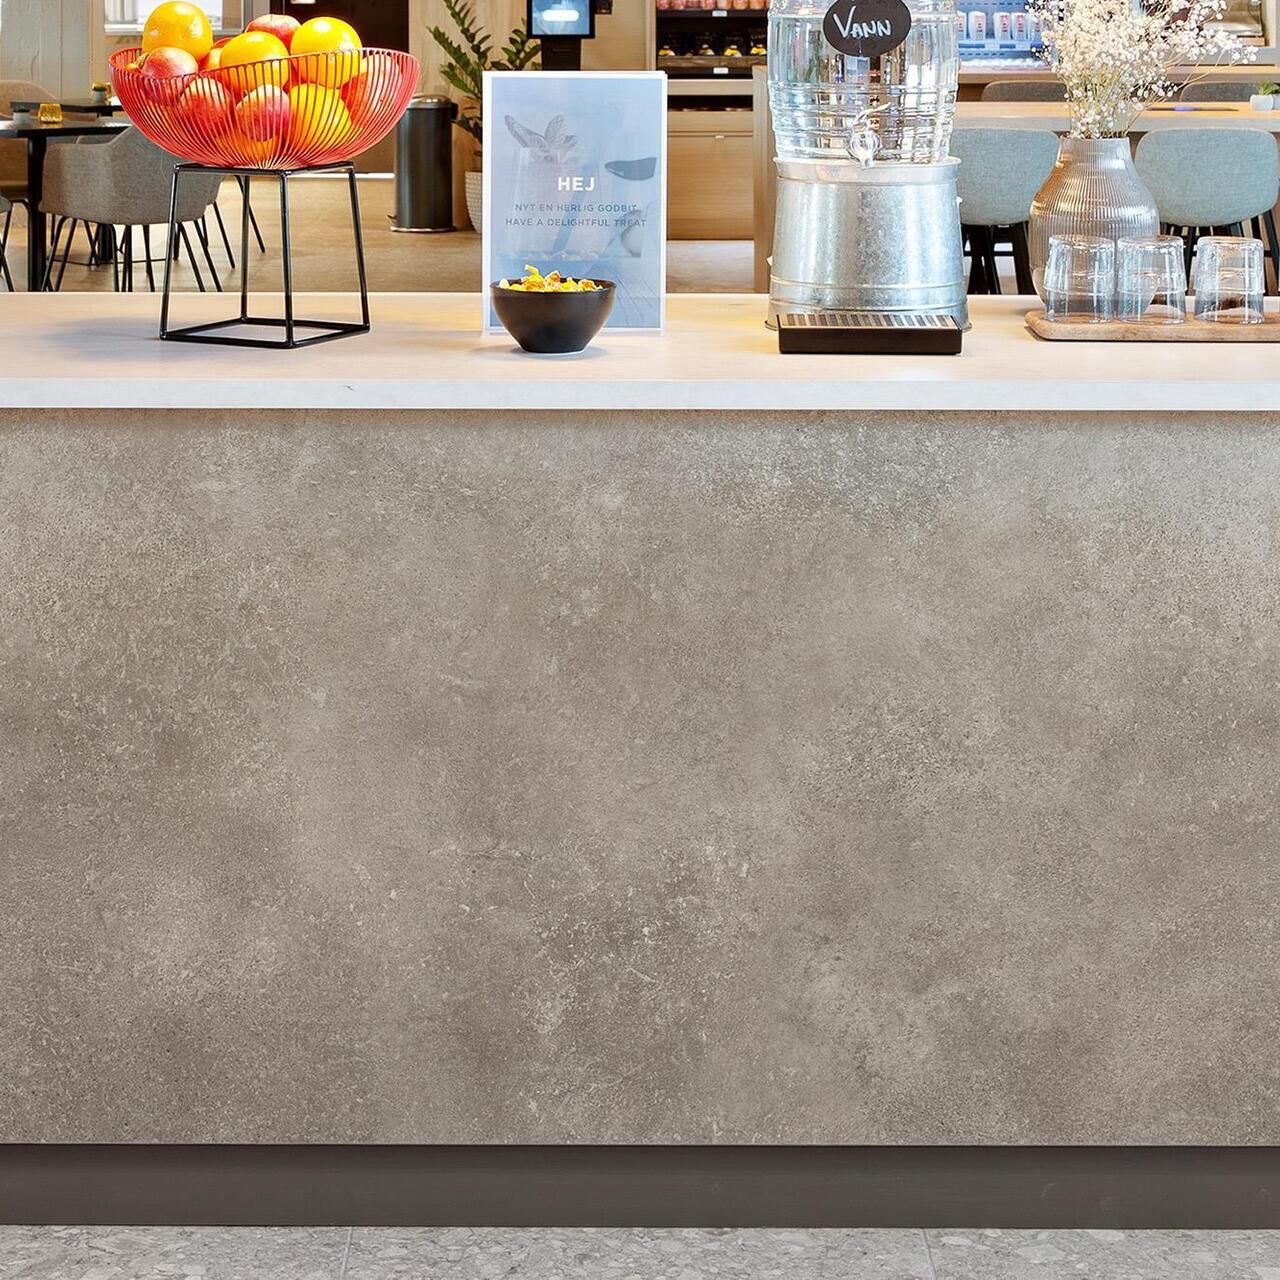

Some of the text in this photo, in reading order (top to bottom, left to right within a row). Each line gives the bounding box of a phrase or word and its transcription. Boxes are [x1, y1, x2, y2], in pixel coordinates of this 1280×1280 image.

[557, 176, 595, 191] HEJ
[515, 203, 639, 212] NYT EN HERLIG GODBIT
[505, 217, 648, 228] HAVE A DELIGHTFUL TREAT
